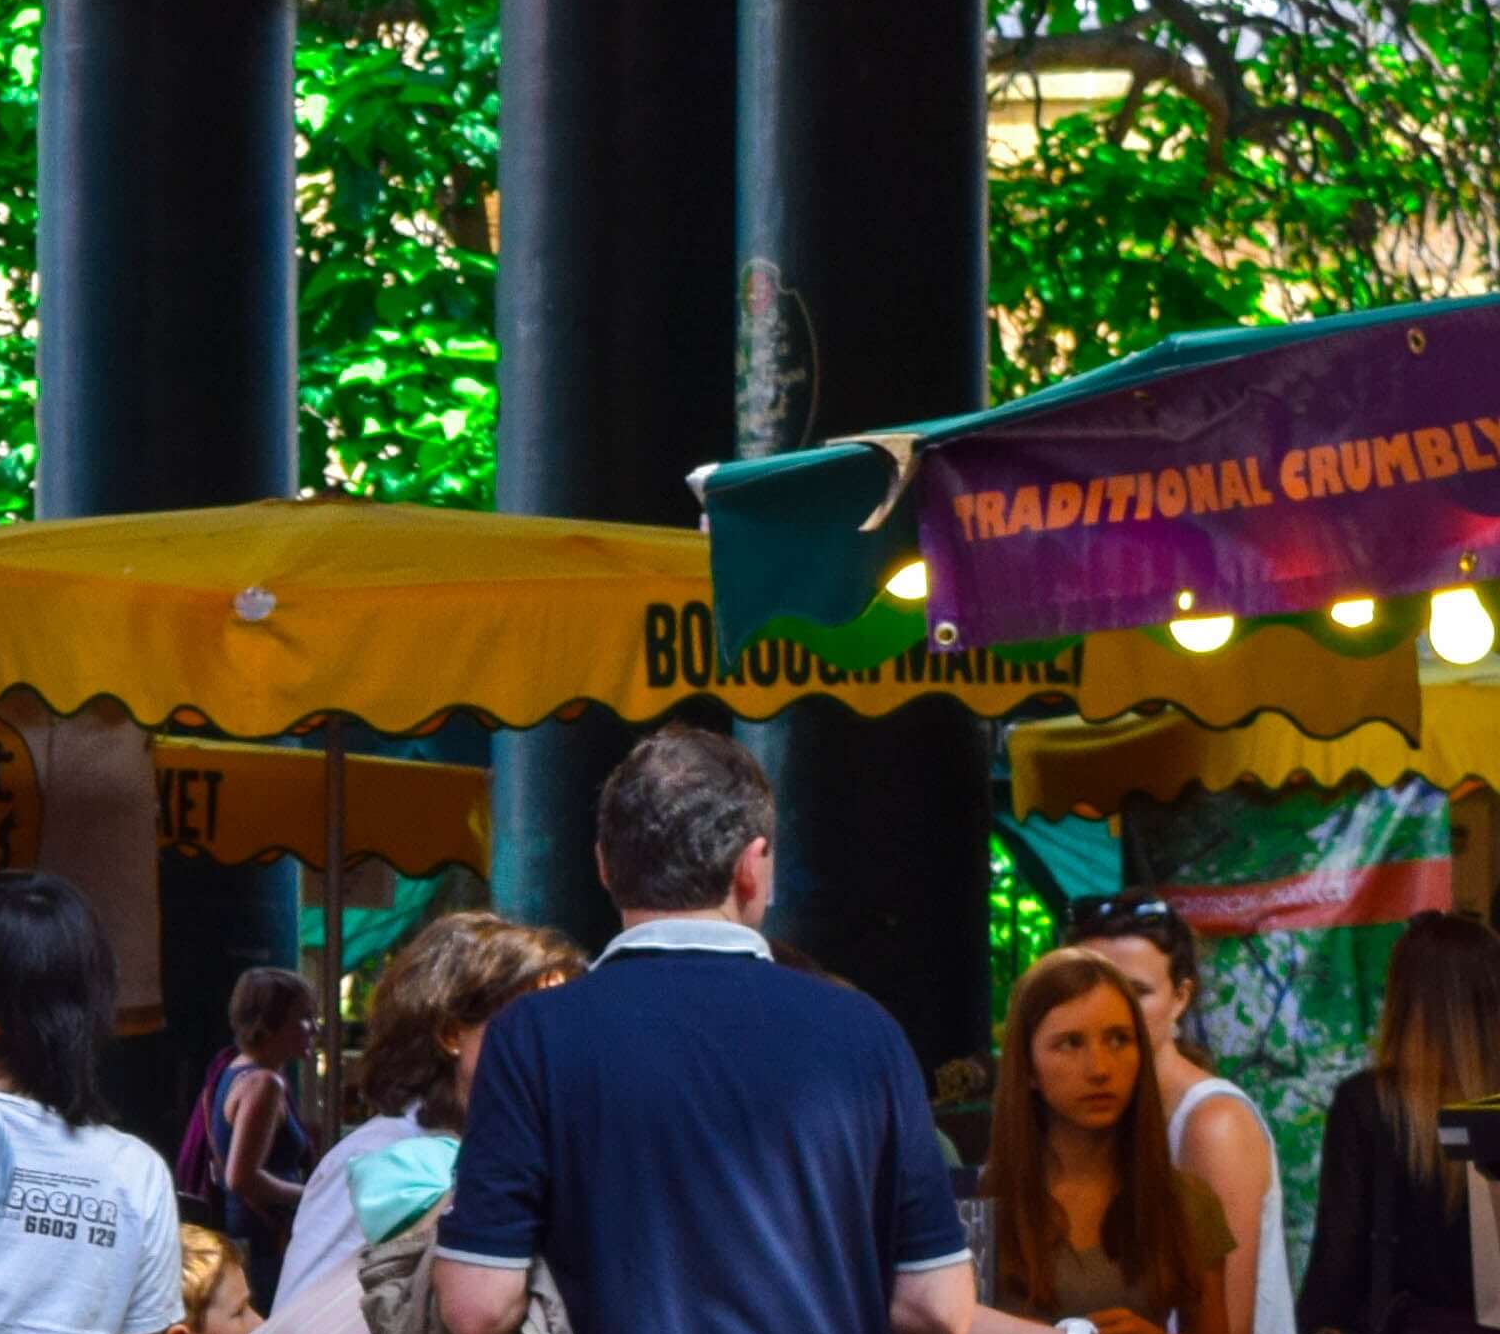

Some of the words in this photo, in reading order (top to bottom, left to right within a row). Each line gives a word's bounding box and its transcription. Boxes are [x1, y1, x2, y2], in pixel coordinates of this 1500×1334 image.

[952, 456, 1275, 542] TRADITIONAL
[645, 600, 882, 688] BOOU
[25, 1214, 77, 1240] 6603
[88, 1226, 117, 1248] 129
